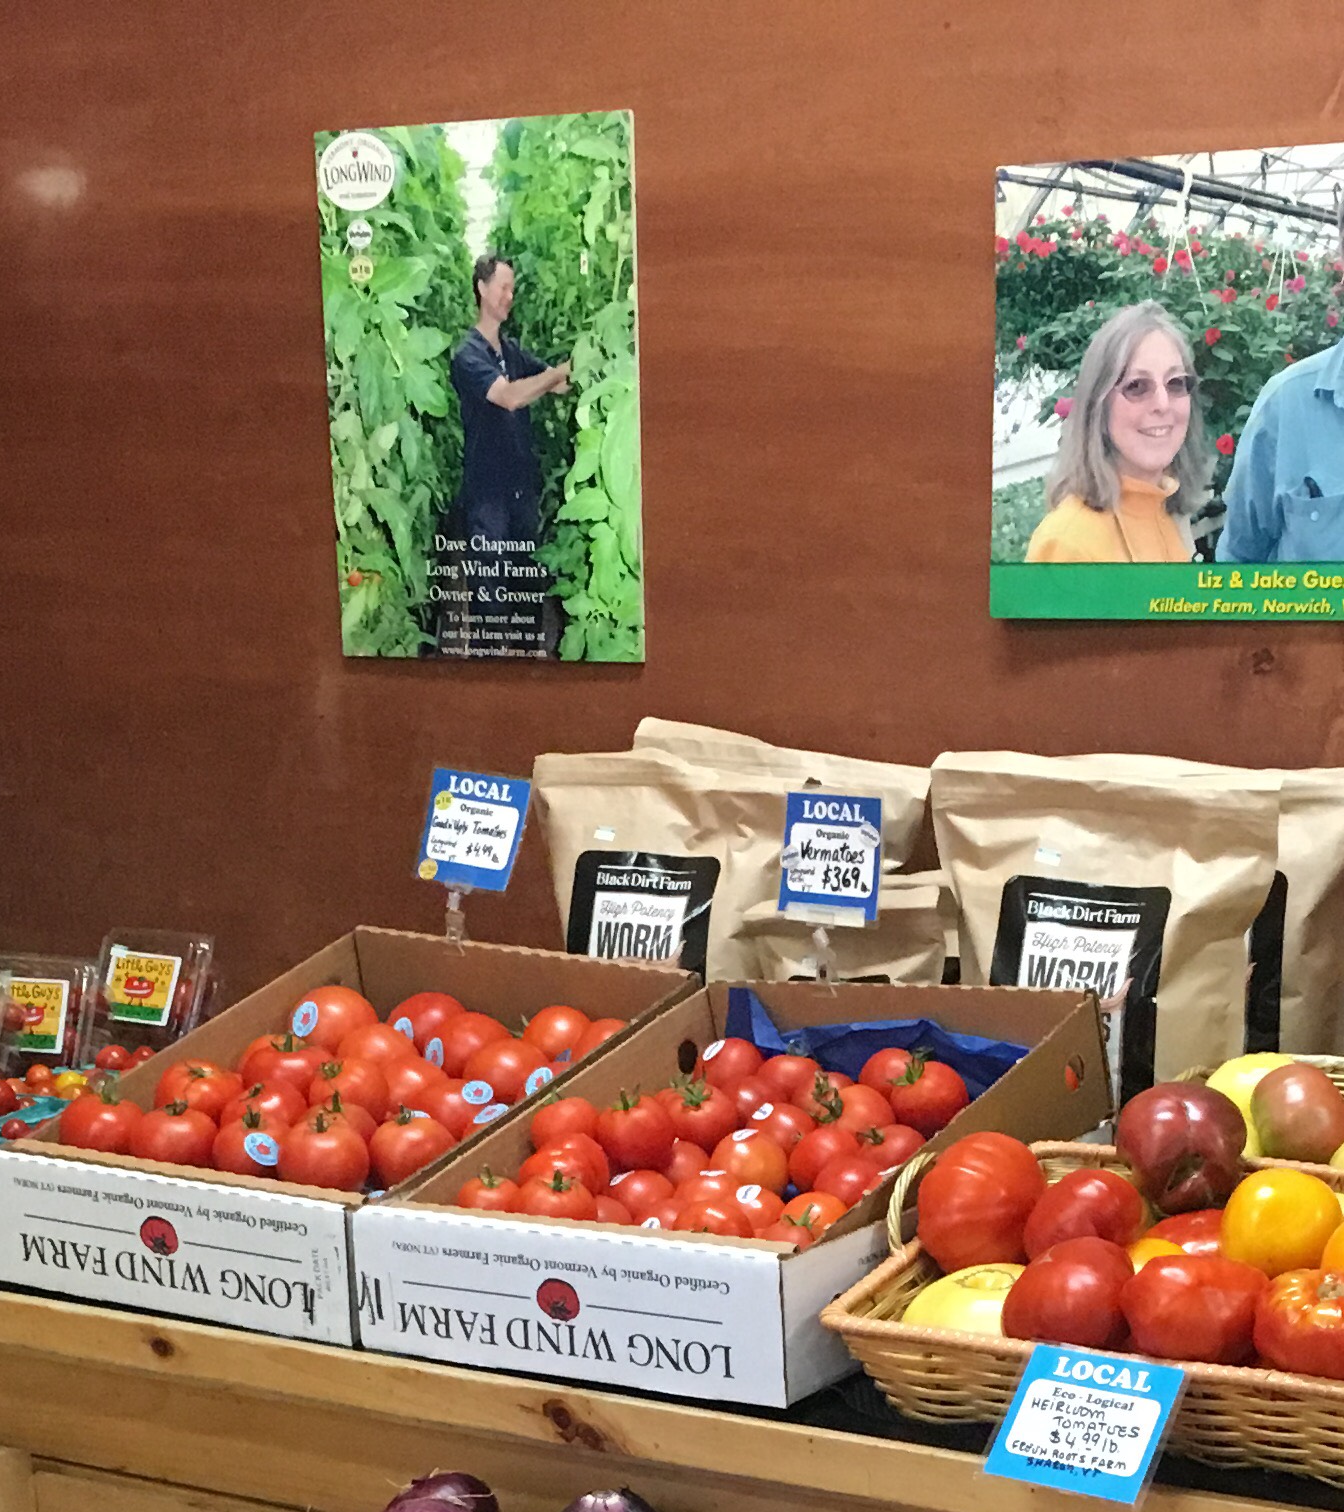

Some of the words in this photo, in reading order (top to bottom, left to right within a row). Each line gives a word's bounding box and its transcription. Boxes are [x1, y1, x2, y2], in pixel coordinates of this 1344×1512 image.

[434, 534, 467, 552] Dave
[470, 534, 536, 555] Chapman
[425, 560, 459, 579] Long
[460, 560, 500, 578] Wind
[503, 560, 547, 578] Farm's
[1197, 571, 1223, 589] Liz
[1229, 572, 1244, 589] &
[1250, 571, 1297, 590] Jake
[429, 584, 474, 602] Owner
[477, 585, 492, 602] &
[495, 586, 546, 604] Grower
[1149, 597, 1208, 614] Killdeer
[1212, 598, 1257, 616] Farm,
[1262, 597, 1336, 617] Norwich,
[448, 774, 513, 802] LOCAL
[460, 803, 494, 816] Organic
[802, 800, 865, 822] LOCAL
[816, 829, 850, 841] Organic
[630, 900, 676, 921] Potency
[596, 921, 673, 960] WORM
[1032, 931, 1070, 953] High
[1073, 935, 1122, 957] Potency
[1027, 954, 1119, 1000] WORM
[57, 1184, 99, 1203] Farmers
[101, 1191, 145, 1210] Organic
[146, 1198, 193, 1218] Vermont
[196, 1205, 210, 1222] by
[212, 1208, 257, 1229] Organic
[260, 1216, 308, 1236] Certified
[20, 1232, 110, 1277] FARM
[442, 1247, 490, 1266] Farmers
[492, 1252, 541, 1271] Organic
[115, 1250, 212, 1296] WIND
[544, 1259, 599, 1279] Vermont
[601, 1263, 617, 1281] by
[620, 1268, 670, 1288] Organic
[219, 1269, 312, 1314] LONG
[675, 1276, 730, 1295] Certified
[398, 1301, 498, 1346] FARM
[505, 1316, 616, 1363] WIND
[626, 1333, 735, 1380] LONG
[1053, 1356, 1151, 1393] LOCAL
[1052, 1387, 1076, 1400] Eco
[1086, 1393, 1134, 1411] Logical
